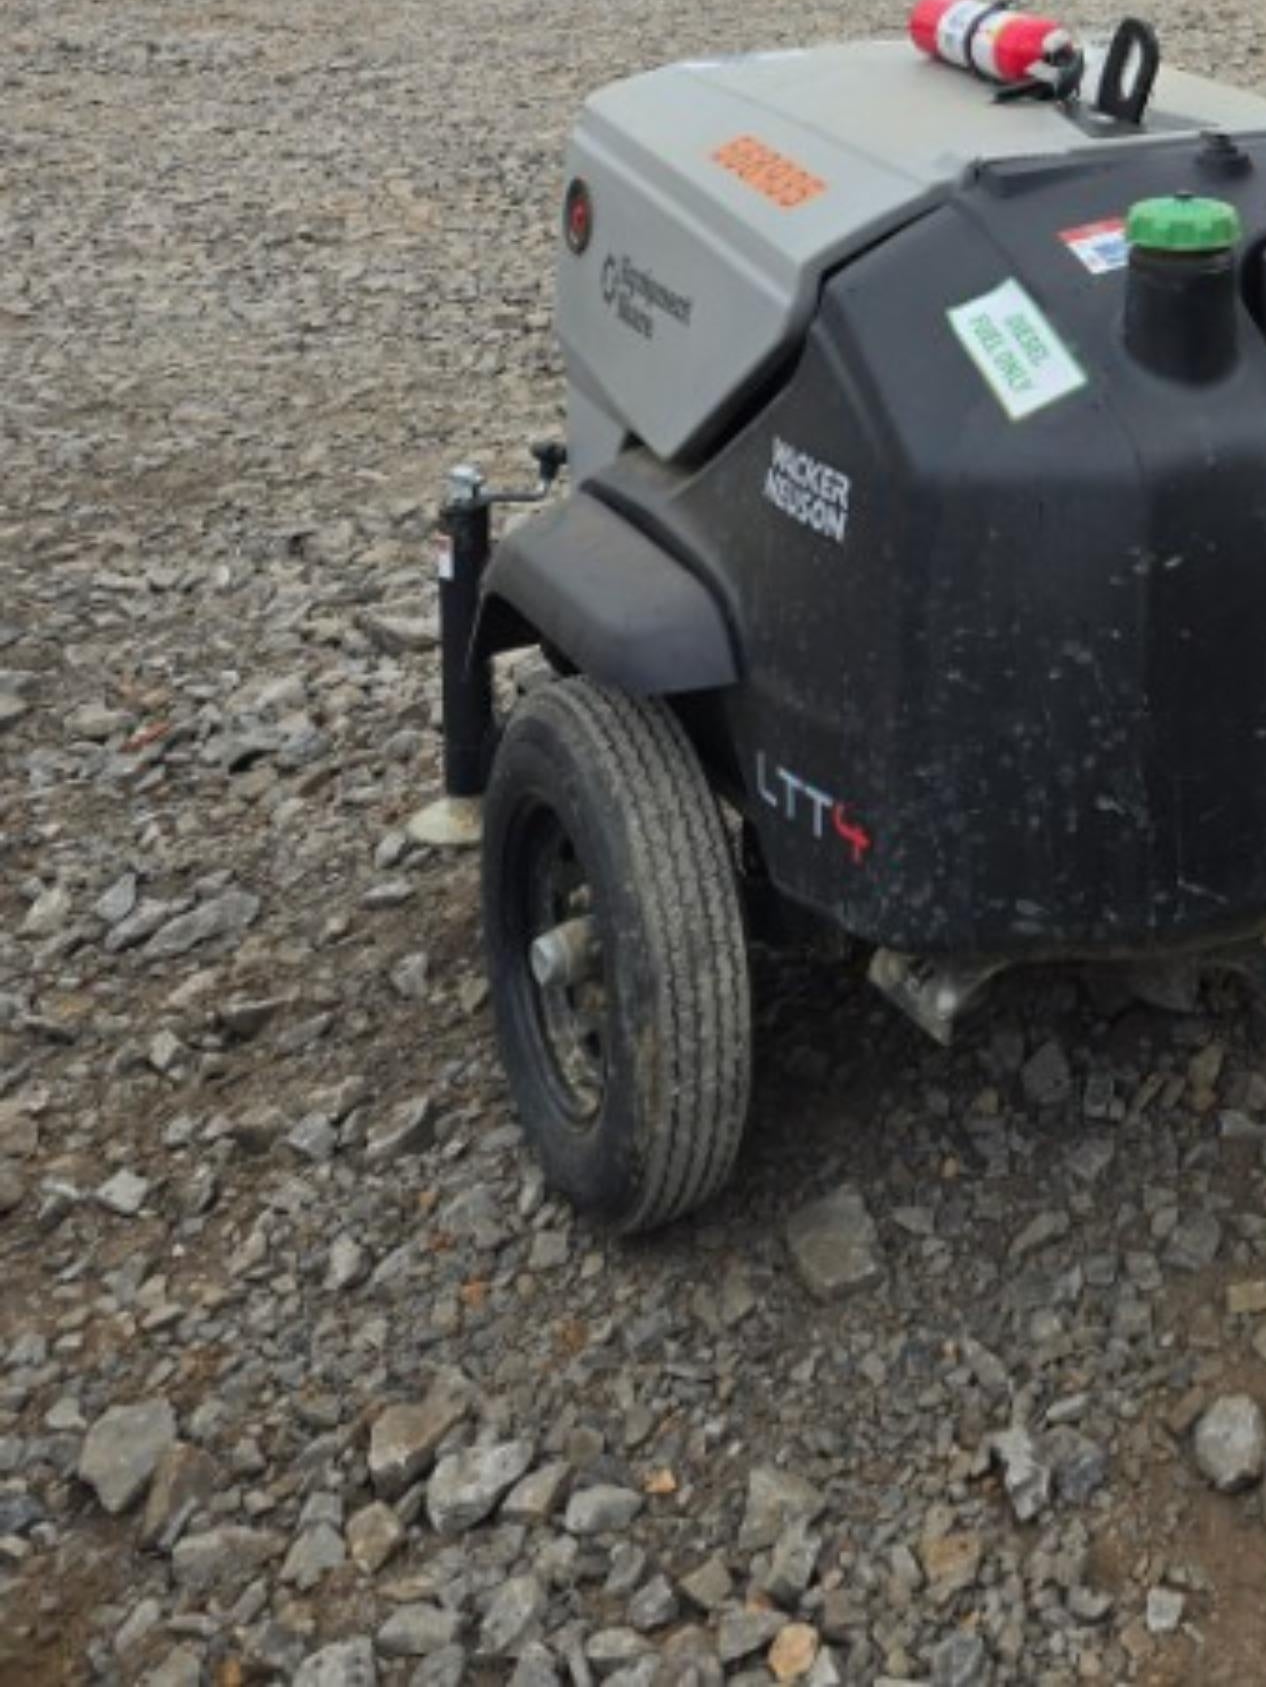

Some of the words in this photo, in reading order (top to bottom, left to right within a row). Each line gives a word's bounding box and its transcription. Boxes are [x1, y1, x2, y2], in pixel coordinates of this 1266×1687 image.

[969, 312, 1004, 355] FUEL
[996, 350, 1033, 392] ONLY
[1005, 312, 1048, 367] DIESEL
[763, 467, 848, 542] NEUSON
[771, 435, 850, 511] WACKER
[756, 750, 870, 865] LTT4
